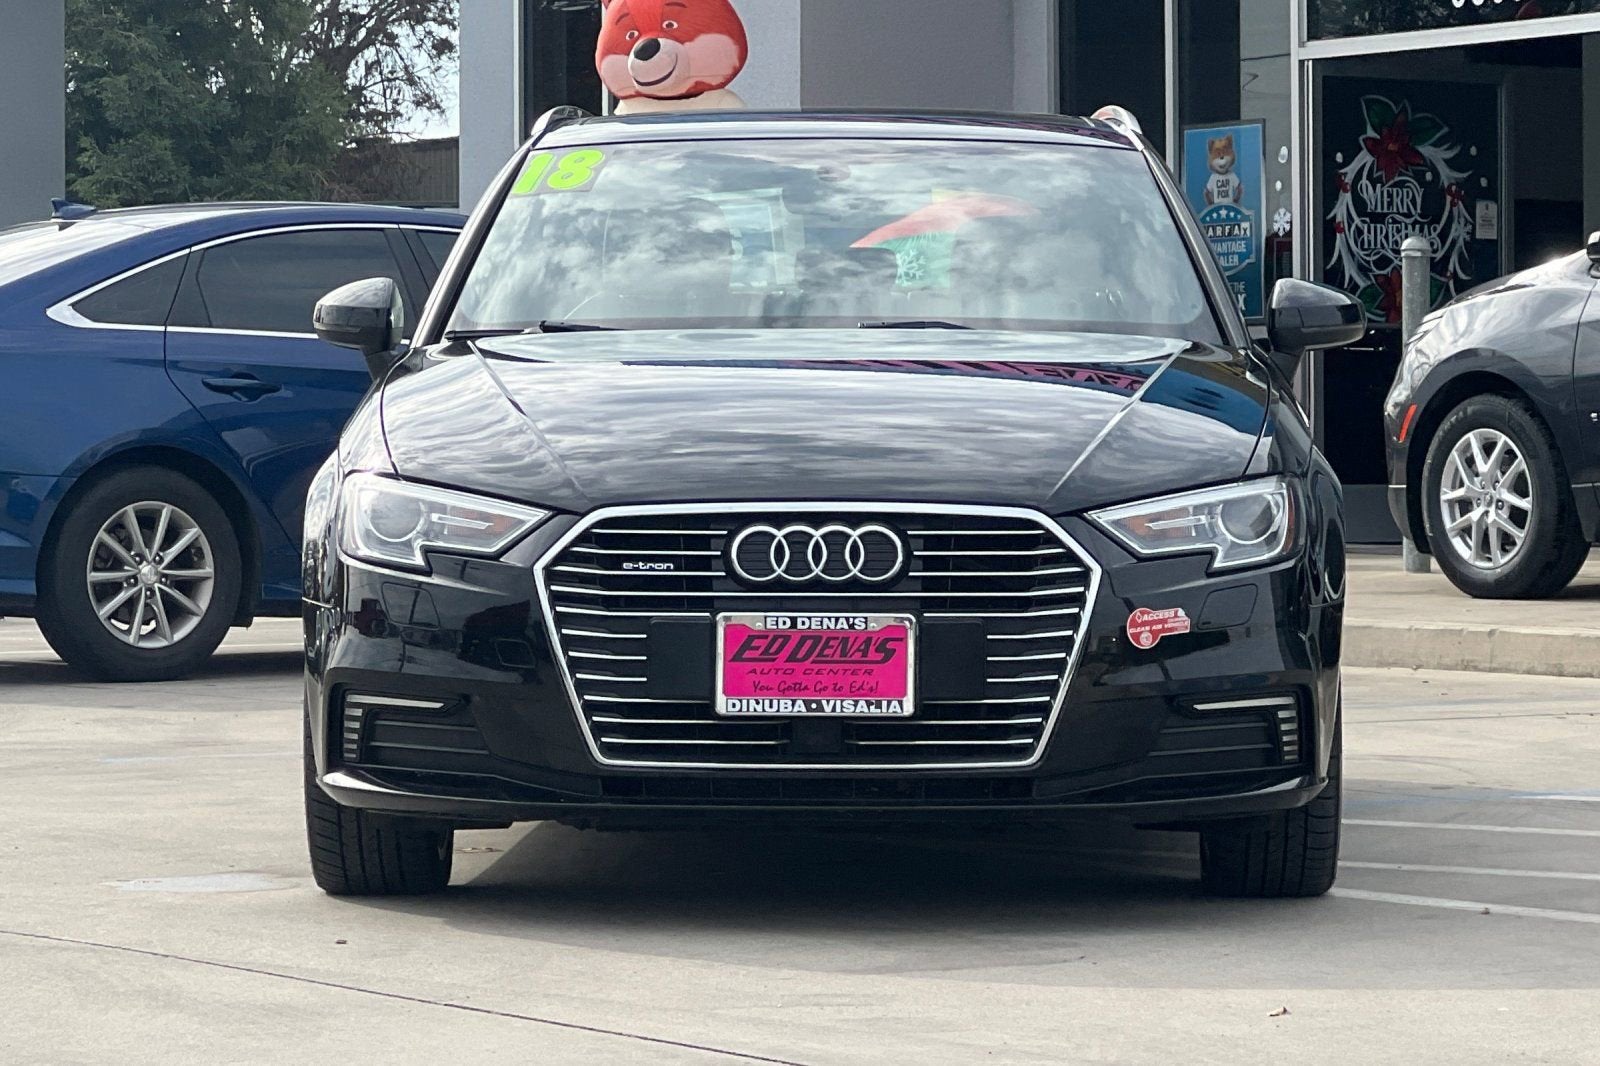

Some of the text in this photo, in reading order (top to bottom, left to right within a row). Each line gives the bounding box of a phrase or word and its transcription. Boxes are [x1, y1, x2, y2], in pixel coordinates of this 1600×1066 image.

[511, 149, 605, 195] 18
[1216, 178, 1230, 189] CAR
[1217, 189, 1230, 199] FOX
[1358, 180, 1425, 214] MERRY
[1205, 222, 1250, 238] ARFAX
[1212, 240, 1247, 254] VANTAGE
[1219, 254, 1239, 267] ALER
[622, 561, 674, 570] e-tron
[766, 616, 867, 630] ED DENA'S
[728, 634, 905, 664] ED DENA'S
[746, 668, 874, 677] AUTO CENTER
[752, 680, 774, 692] You
[777, 680, 809, 694] Gotta
[813, 680, 829, 694] Go
[832, 680, 844, 693] to
[727, 699, 904, 714] DINUBA VISALIA
